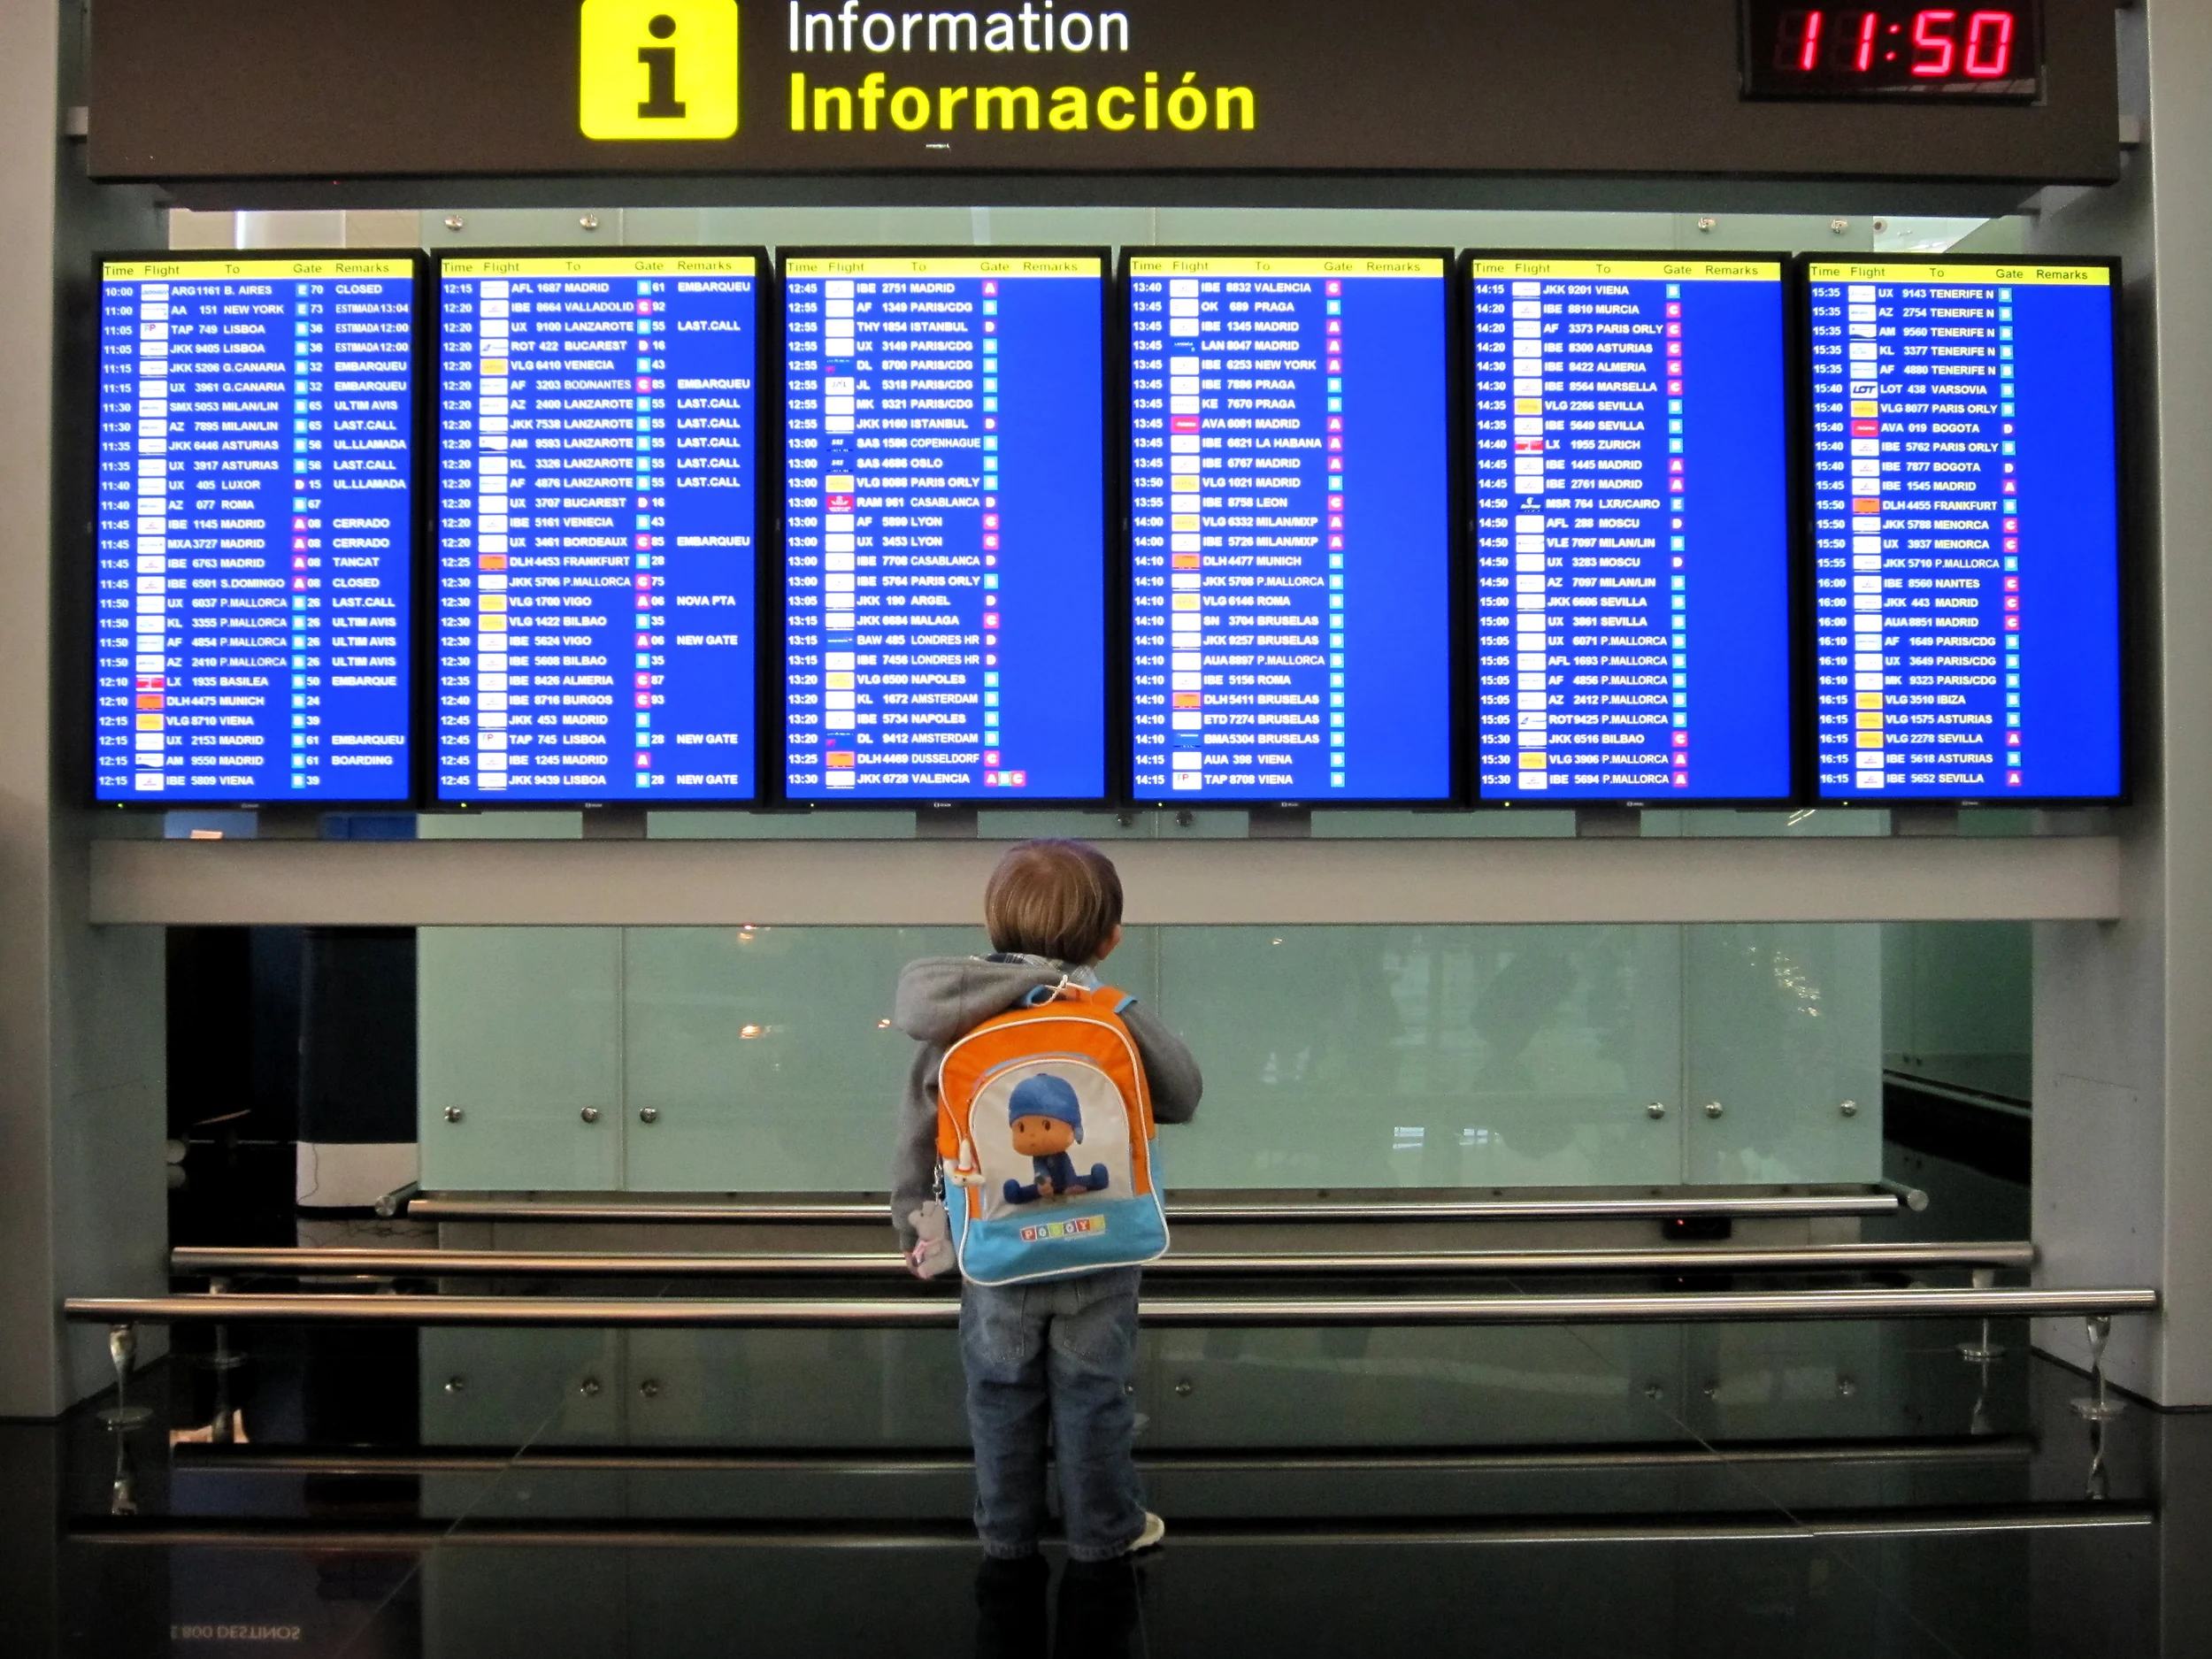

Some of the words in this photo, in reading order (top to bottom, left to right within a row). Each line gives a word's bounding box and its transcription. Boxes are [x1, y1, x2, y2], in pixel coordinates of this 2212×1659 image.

[789, 0, 1130, 56] Information
[1799, 10, 2012, 76] 11:50
[790, 70, 1256, 131] Información
[104, 265, 134, 276] Time
[144, 264, 179, 278] Flight
[226, 263, 240, 274] To
[294, 263, 322, 274] Gate
[336, 263, 388, 273] Remarks
[442, 262, 472, 273] Time
[483, 262, 519, 275] Flight
[565, 261, 580, 272] To
[634, 261, 664, 272] Gate
[678, 260, 732, 272] Remarks
[787, 262, 818, 273] Time
[828, 262, 864, 275] Flight
[911, 261, 926, 273] To
[980, 261, 1010, 273] Gate
[1023, 261, 1078, 273] Remarks
[1132, 260, 1162, 272] Time
[1173, 261, 1209, 275] Flight
[1255, 260, 1271, 272] To
[1324, 261, 1353, 273] Gate
[1367, 261, 1420, 273] Remarks
[1474, 263, 1504, 273] Time
[1515, 263, 1550, 277] Flight
[1596, 263, 1610, 274] To
[1663, 265, 1692, 276] Gate
[1705, 265, 1758, 276] Remarks
[1811, 266, 1840, 278] Time
[1850, 267, 1885, 280] Flight
[1929, 267, 1944, 279] To
[1996, 269, 2023, 280] Gate
[2036, 269, 2087, 280] Remarks
[444, 284, 472, 293] 12:15
[511, 283, 533, 293] AFL
[565, 283, 609, 292] MADRID
[652, 282, 664, 291] 61
[678, 282, 750, 292] EMBARQUEU
[788, 283, 818, 293] 12:45
[856, 283, 876, 293] IBE
[882, 283, 906, 293] 2751
[910, 283, 955, 293] MADRID
[1878, 288, 1893, 297] UX
[1930, 289, 1983, 298] TENERIFE
[105, 306, 133, 315] 11:00
[200, 305, 217, 314] 151
[224, 305, 250, 314] NEW
[311, 304, 323, 313] 73
[1133, 302, 1162, 311] 13:45
[1201, 302, 1217, 311] OK
[1255, 302, 1294, 311] PRAGA
[1477, 323, 1505, 333] 14:20
[1544, 324, 1558, 333] AF
[1569, 324, 1593, 333] 3373
[1596, 324, 1630, 334] PARIS
[1632, 325, 1663, 334] ORLY
[443, 342, 472, 351] 12:20
[511, 342, 535, 351] ROT
[539, 342, 558, 350] 422
[565, 341, 626, 350] BUCAREST
[653, 341, 665, 349] 16
[1133, 360, 1162, 369] 13:45
[1202, 359, 1221, 370] IBE
[1255, 360, 1281, 370] NEW
[1284, 360, 1316, 370] YORK
[170, 383, 185, 392] UX
[196, 383, 218, 392] 3961
[223, 382, 285, 391] G.CANARIA
[310, 382, 322, 391] 32
[334, 381, 406, 391] EMBARQUEU
[1815, 384, 1842, 393] 15:40
[1932, 385, 1986, 394] VARSOVIA
[103, 481, 130, 490] 11:40
[196, 480, 215, 489] 405
[222, 480, 260, 489] LUXOR
[309, 480, 321, 488] 15
[334, 480, 406, 488] UL.LLAMADA
[788, 498, 818, 507] 13:00
[856, 497, 882, 507] RAM
[910, 497, 979, 507] CASABLANCA
[1479, 499, 1508, 508] 14:50
[1546, 499, 1571, 508] MSR
[1575, 499, 1593, 508] 764
[1599, 499, 1660, 509] LXR/CAIRO
[101, 559, 128, 568] 11:45
[168, 559, 187, 568] IBE
[220, 558, 265, 567] MADRID
[333, 557, 380, 566] TANCAT
[442, 597, 471, 606] 12:30
[509, 597, 533, 606] VLG
[563, 596, 591, 606] VIGO
[677, 596, 710, 605] NOVA
[712, 595, 735, 605] PTA
[788, 635, 818, 645] 13:15
[857, 635, 882, 645] BAW
[911, 635, 962, 645] LONDRES
[964, 635, 979, 644] HR
[442, 735, 470, 744] 12:45
[509, 735, 533, 744] TAP
[538, 735, 557, 744] 745
[563, 734, 606, 744] LISBOA
[677, 734, 703, 744] NEW
[706, 734, 738, 743] GATE
[1482, 734, 1510, 743] 15:30
[1548, 734, 1571, 743] JKK
[1601, 734, 1644, 743] BILBAO
[99, 757, 127, 765] 12:15
[219, 757, 264, 765] MADRID
[332, 756, 393, 764] BOARDING
[1136, 755, 1164, 764] 14:15
[1204, 755, 1228, 764] AUA
[1257, 755, 1292, 764] VIENA
[1887, 774, 1905, 783] IBE
